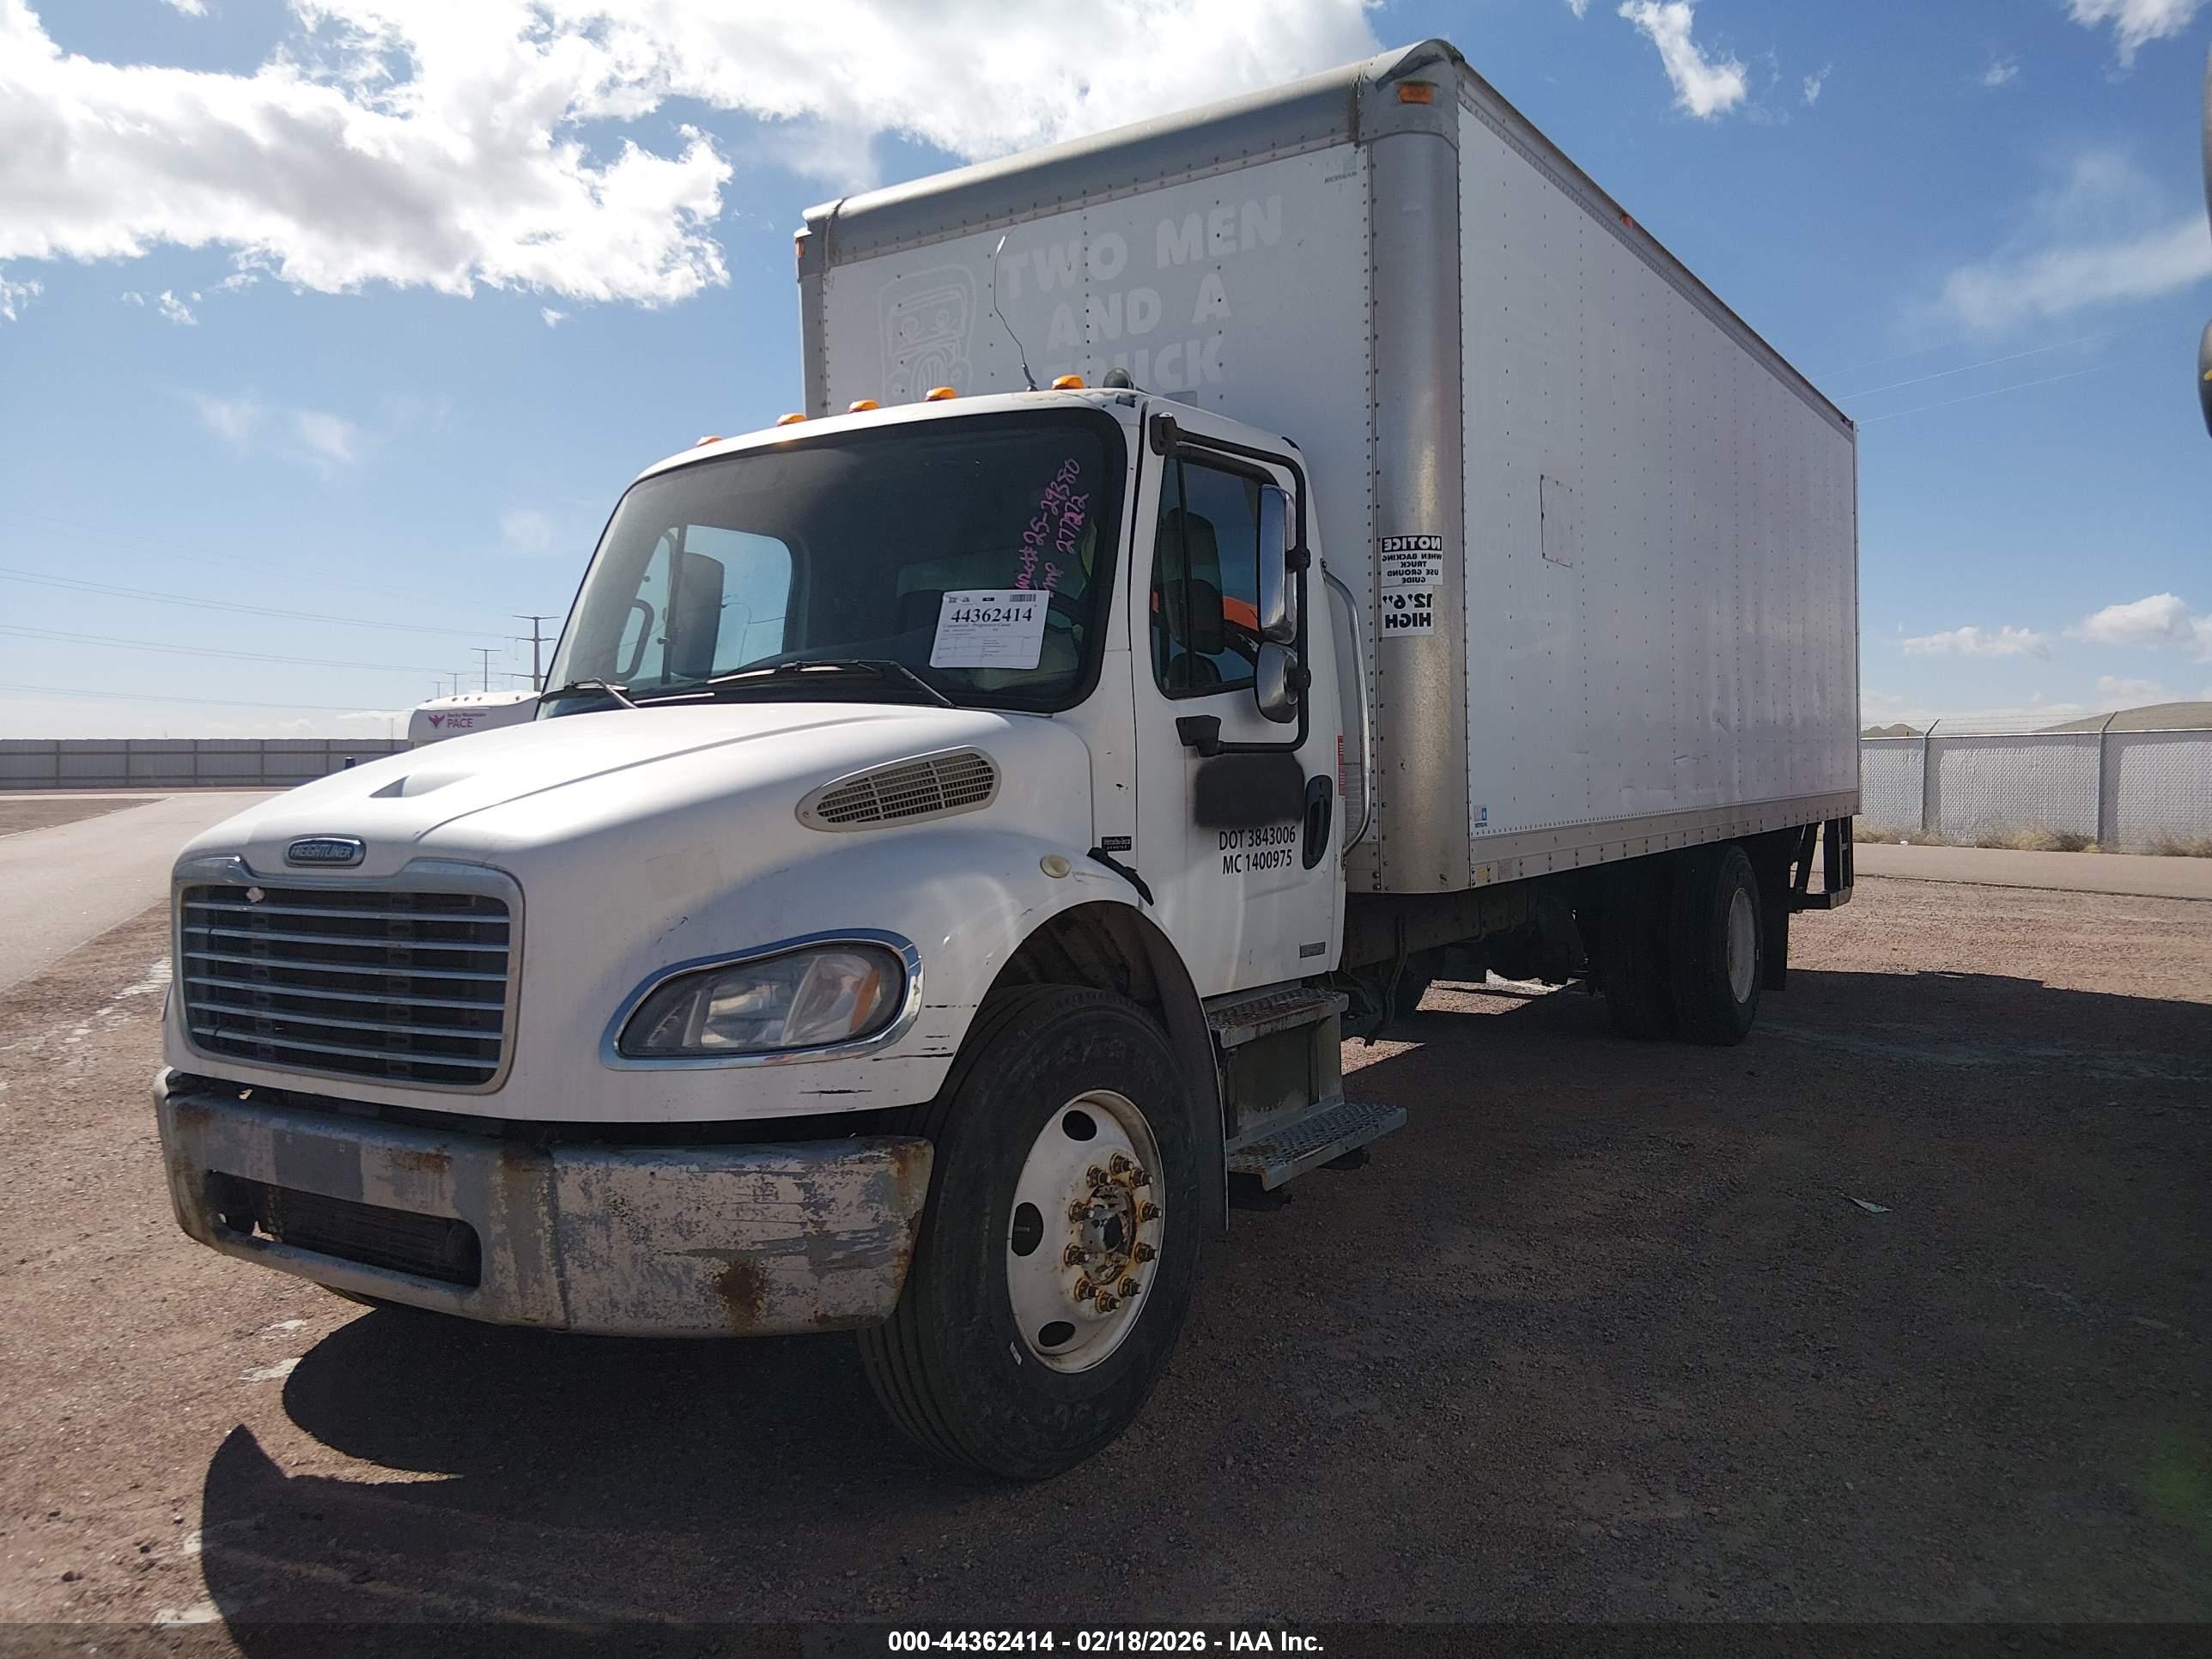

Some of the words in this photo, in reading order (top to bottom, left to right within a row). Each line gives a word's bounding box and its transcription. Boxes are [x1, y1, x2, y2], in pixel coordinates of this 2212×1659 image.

[999, 234, 1127, 301] TWO
[1157, 195, 1285, 270] MEN
[1045, 287, 1164, 352] AND
[1193, 274, 1232, 324] A
[1023, 458, 1080, 546] 25-29380
[951, 607, 1032, 623] 44362414
[447, 718, 473, 728] PACE
[1219, 830, 1244, 850] DOT
[1248, 825, 1296, 848] 3843006
[290, 844, 351, 858] FREIGHTLINER
[1223, 854, 1242, 874] MC
[1245, 849, 1292, 872] 1400975
